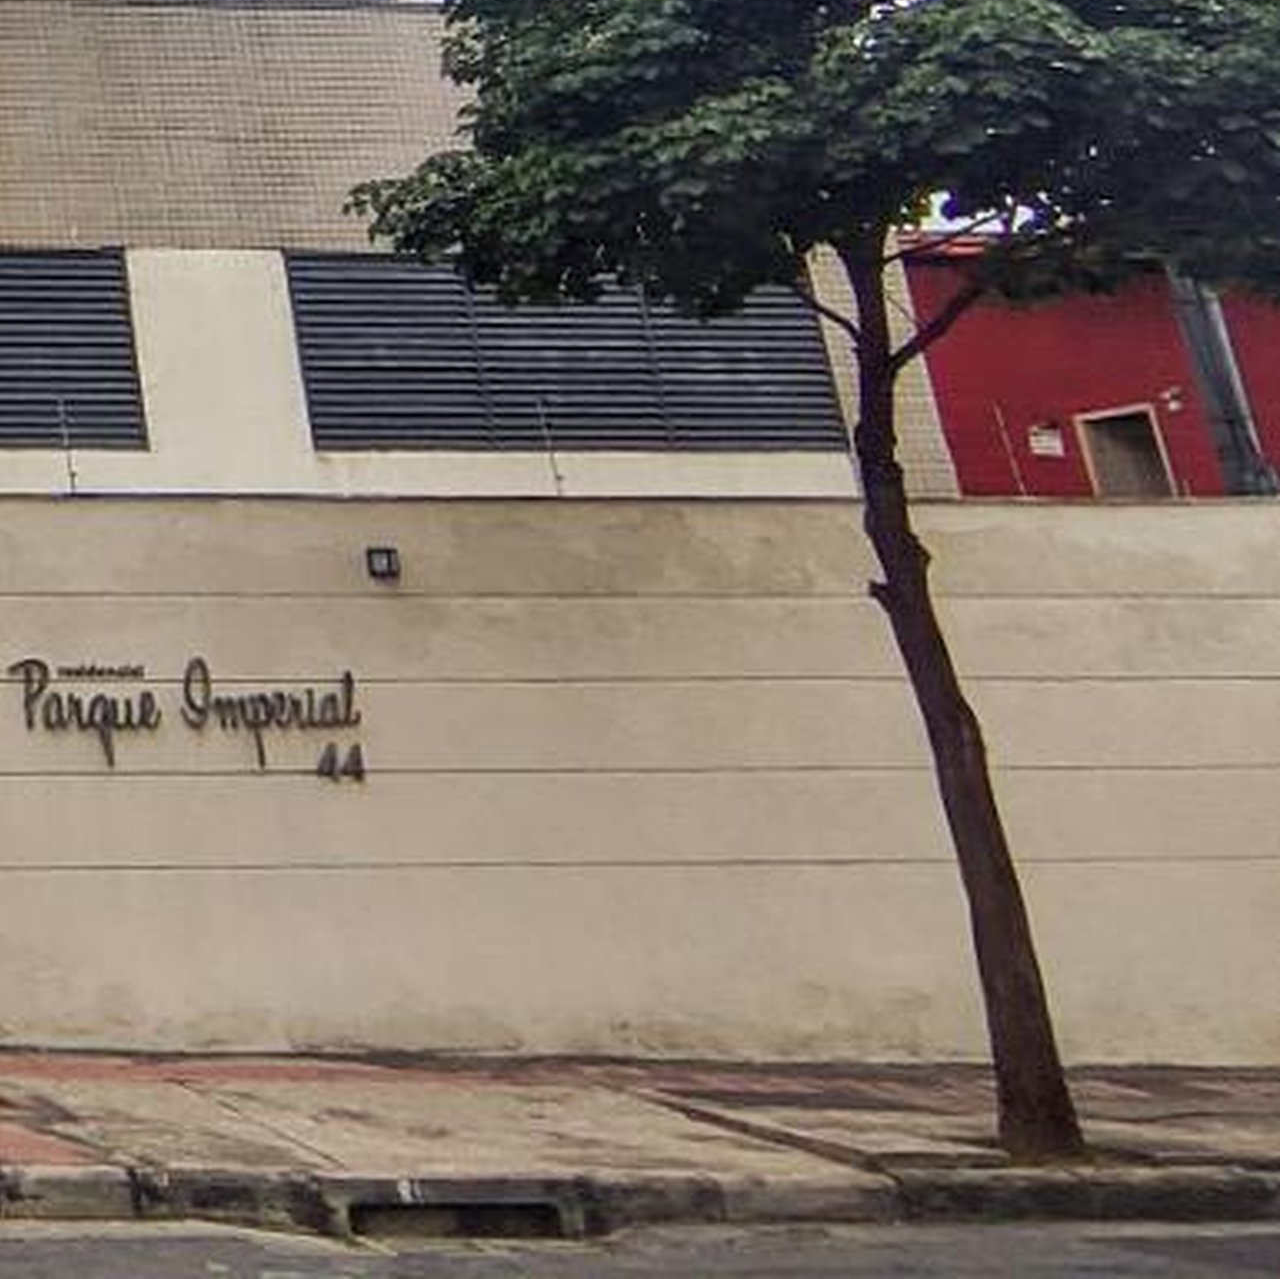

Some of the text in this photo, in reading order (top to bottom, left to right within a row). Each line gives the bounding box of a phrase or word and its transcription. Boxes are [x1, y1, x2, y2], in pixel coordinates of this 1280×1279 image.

[8, 657, 361, 768] Parque Imperial
[317, 741, 364, 783] 44
